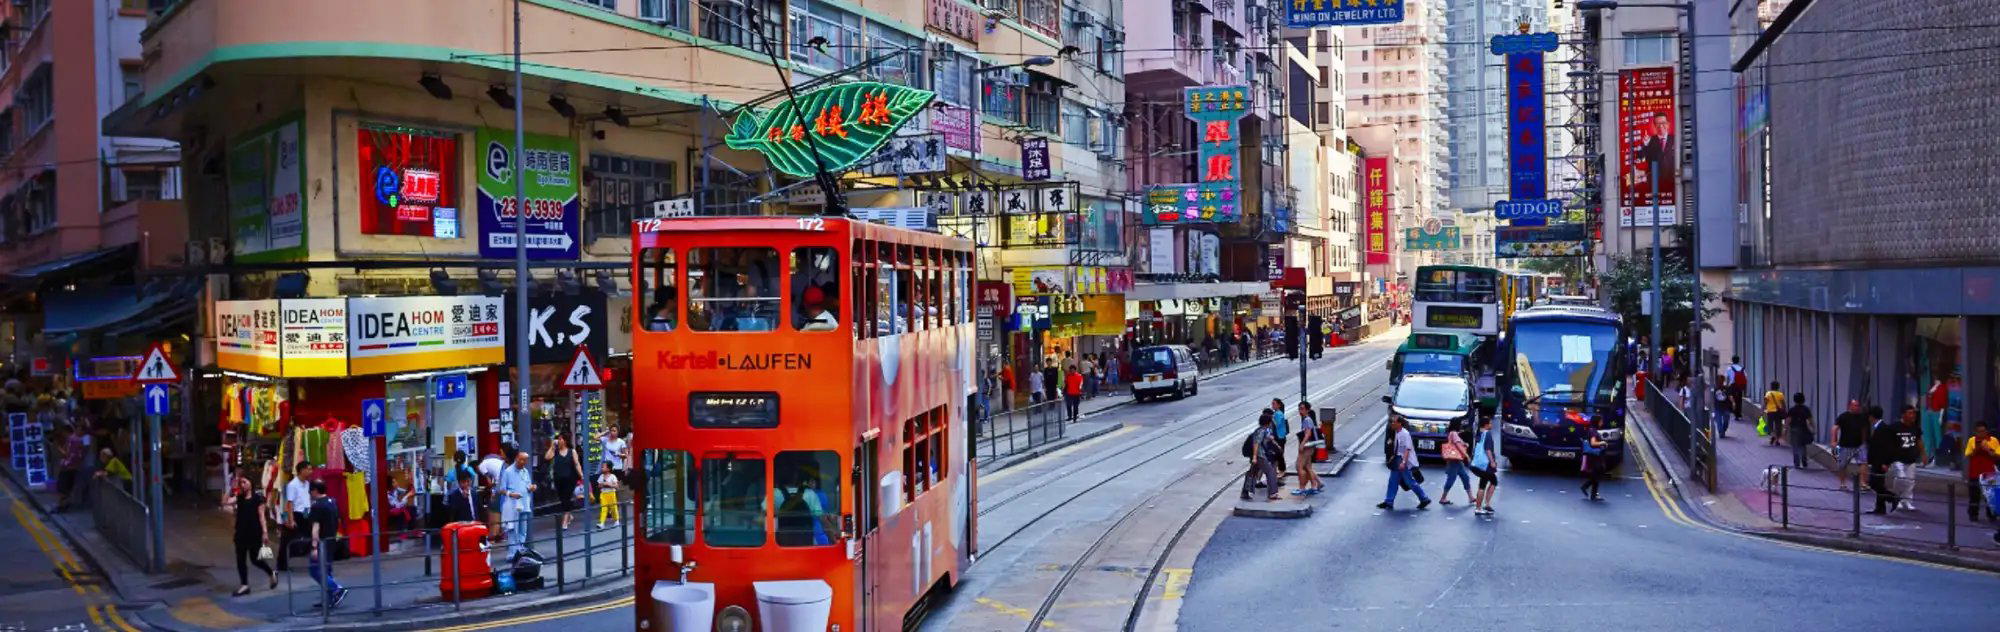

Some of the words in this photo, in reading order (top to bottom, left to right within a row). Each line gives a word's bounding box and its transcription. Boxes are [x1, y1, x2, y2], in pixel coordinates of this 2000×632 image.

[1293, 13, 1315, 22] WING
[1318, 12, 1330, 21] ON
[1332, 10, 1374, 20] JEWELRY
[1378, 8, 1398, 19] LTD.
[1370, 168, 1384, 252] 仟輝集團
[1499, 201, 1561, 216] TUDOR
[637, 219, 662, 233] 172
[797, 217, 825, 231] 172
[284, 309, 319, 324] IDEA
[412, 310, 444, 325] HOM
[452, 303, 498, 323] 愛迪家
[358, 312, 410, 339] IDEA
[413, 326, 444, 336] CENTRE
[657, 351, 718, 370] Kartell
[727, 353, 812, 370] LAUFEN
